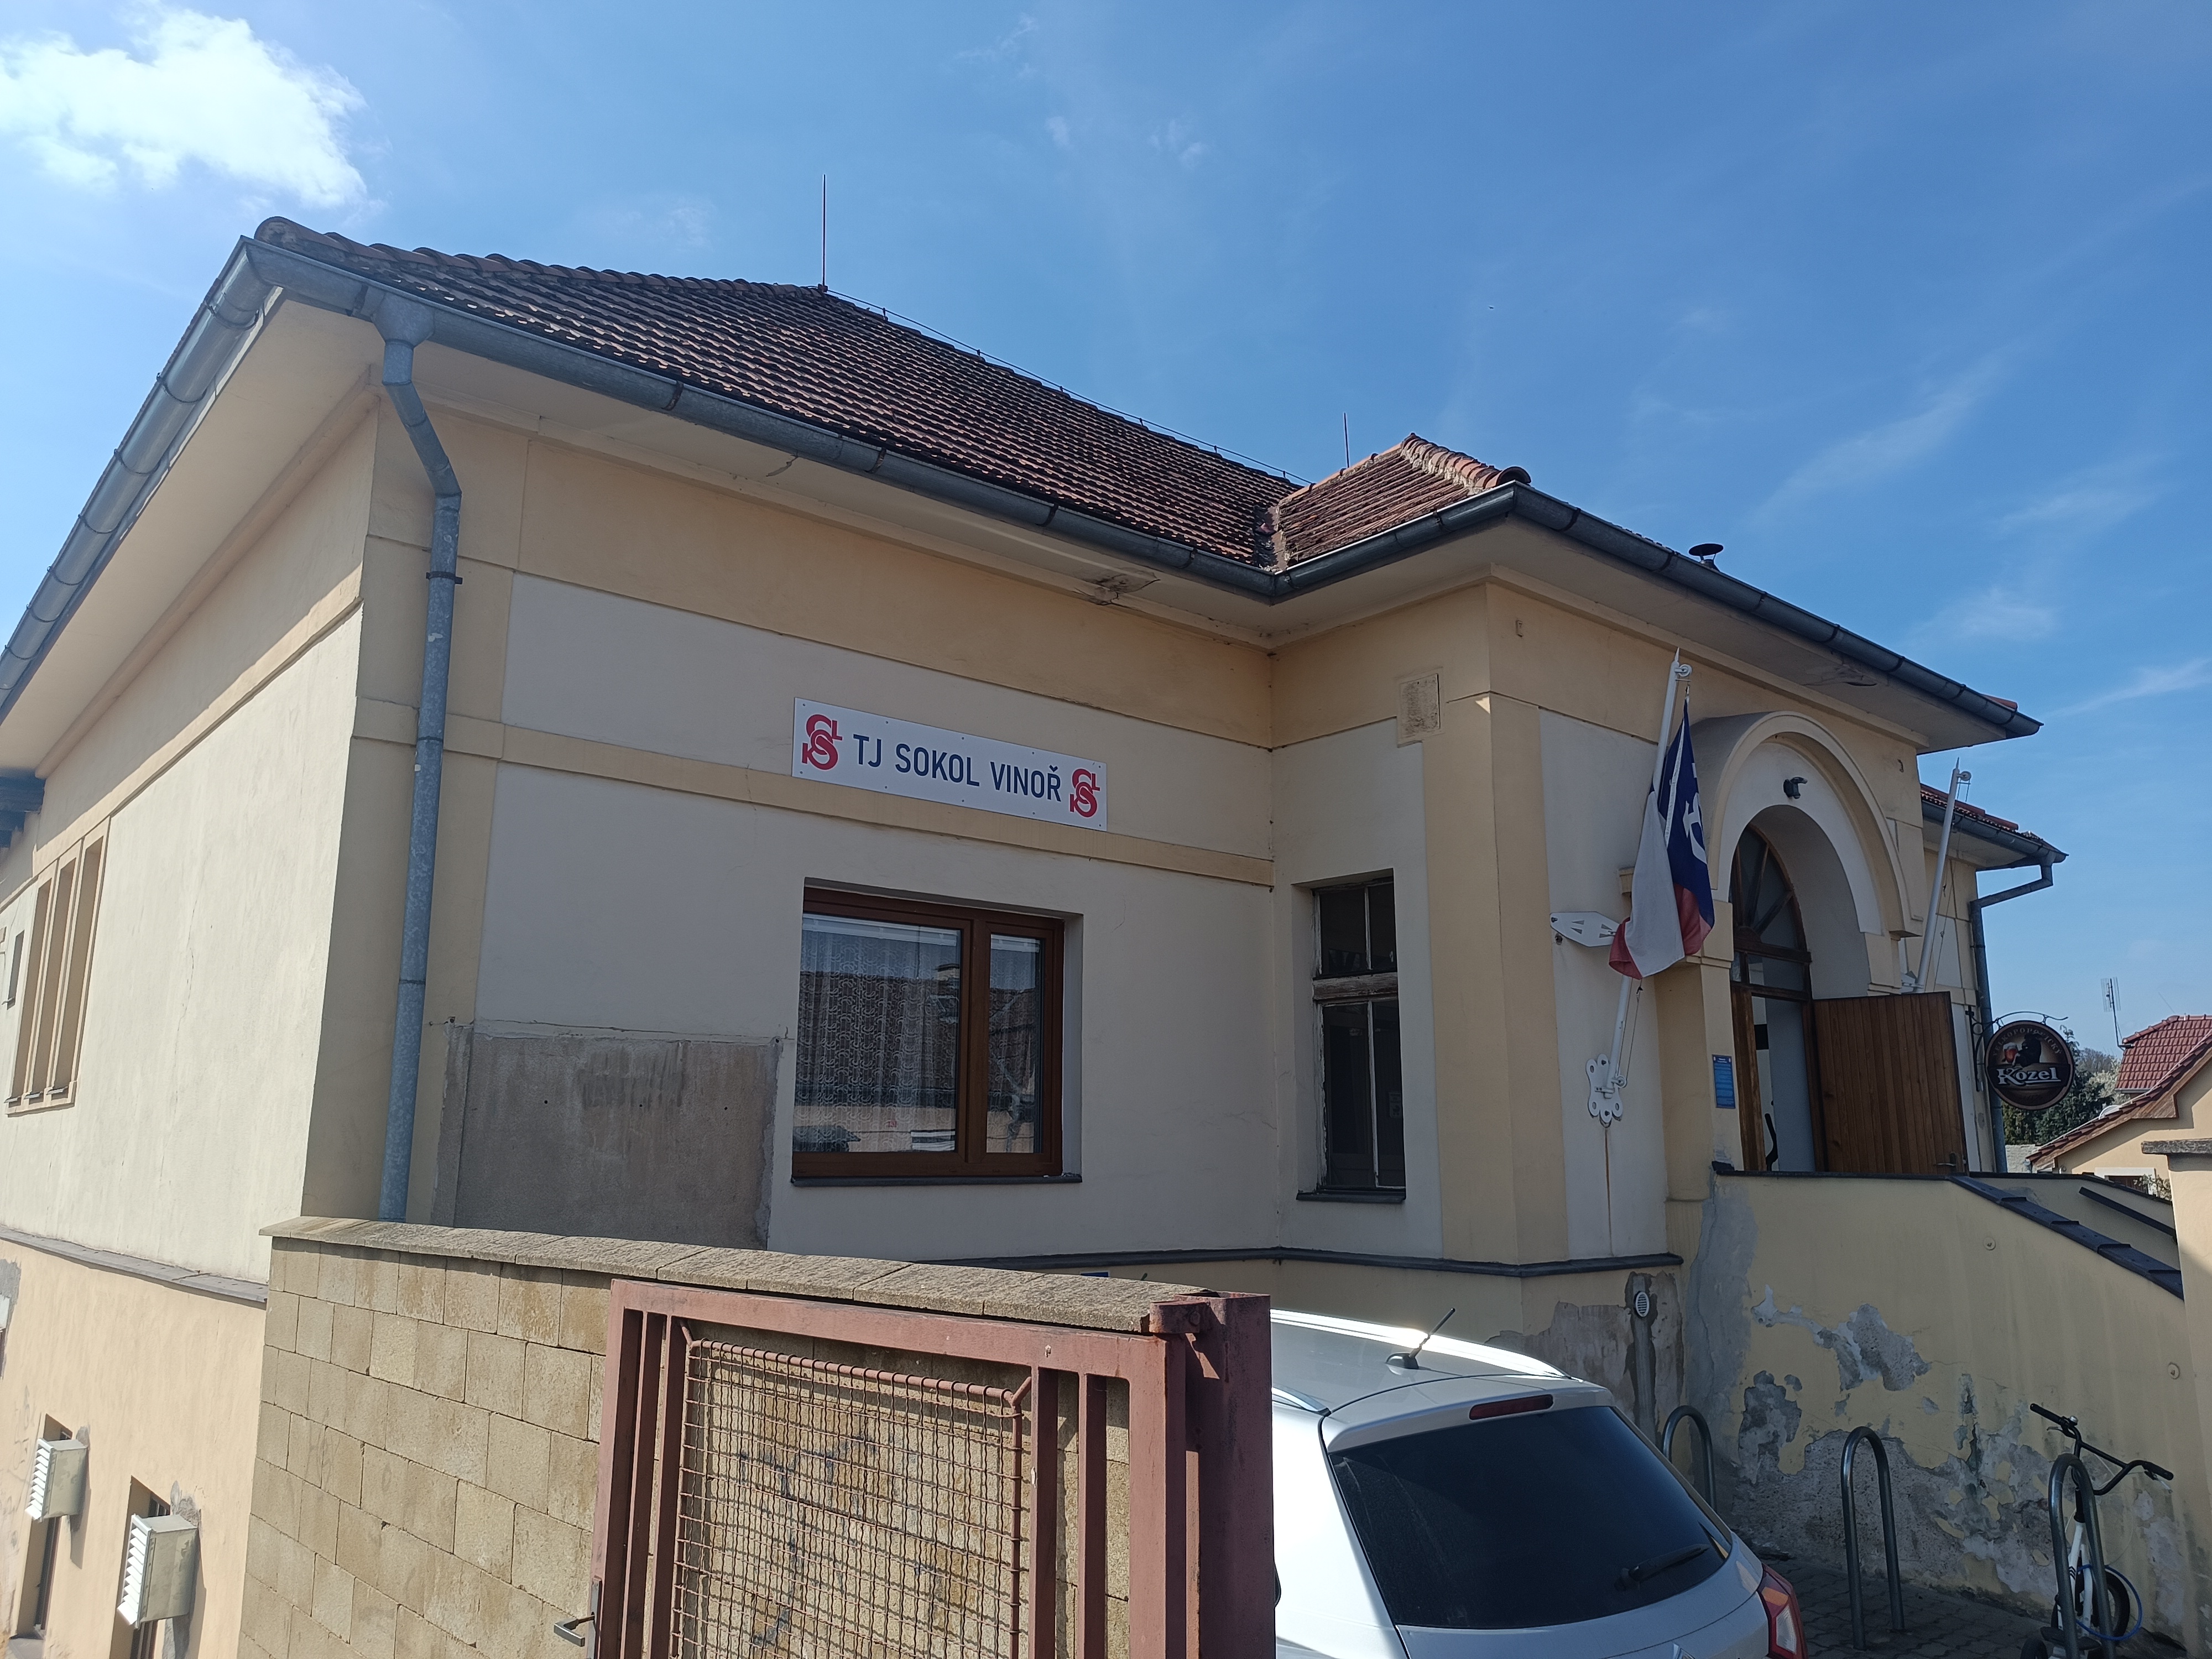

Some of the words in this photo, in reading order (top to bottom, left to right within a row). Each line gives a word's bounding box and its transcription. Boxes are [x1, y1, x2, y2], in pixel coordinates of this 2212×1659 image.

[853, 734, 882, 768] TJ
[895, 744, 980, 787] SOKOL
[990, 761, 1061, 802] VINOŘ
[1996, 1067, 2060, 1085] Kozel
